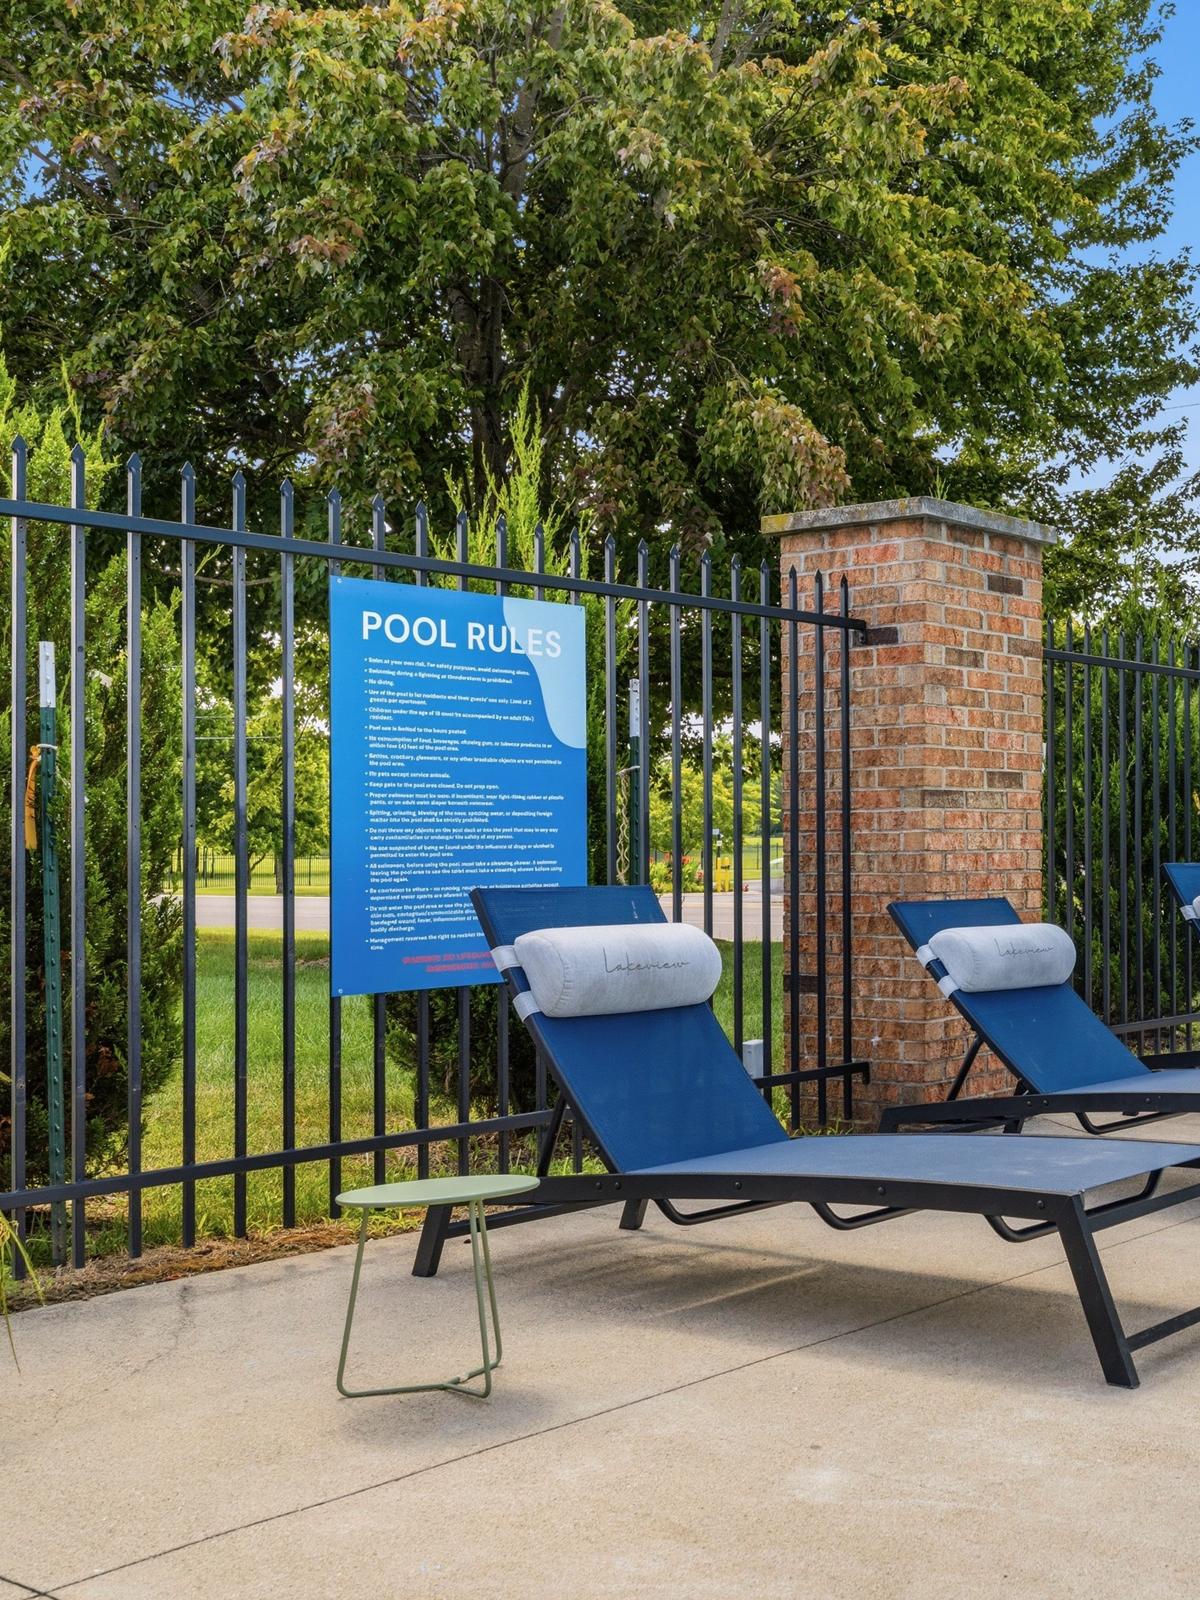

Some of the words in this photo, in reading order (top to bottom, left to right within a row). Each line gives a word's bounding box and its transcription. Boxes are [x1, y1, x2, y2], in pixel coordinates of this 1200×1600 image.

[362, 611, 456, 648] POOL
[467, 622, 561, 658] RULES
[602, 947, 691, 976] Lakeview
[994, 938, 1055, 958] Lakeview
